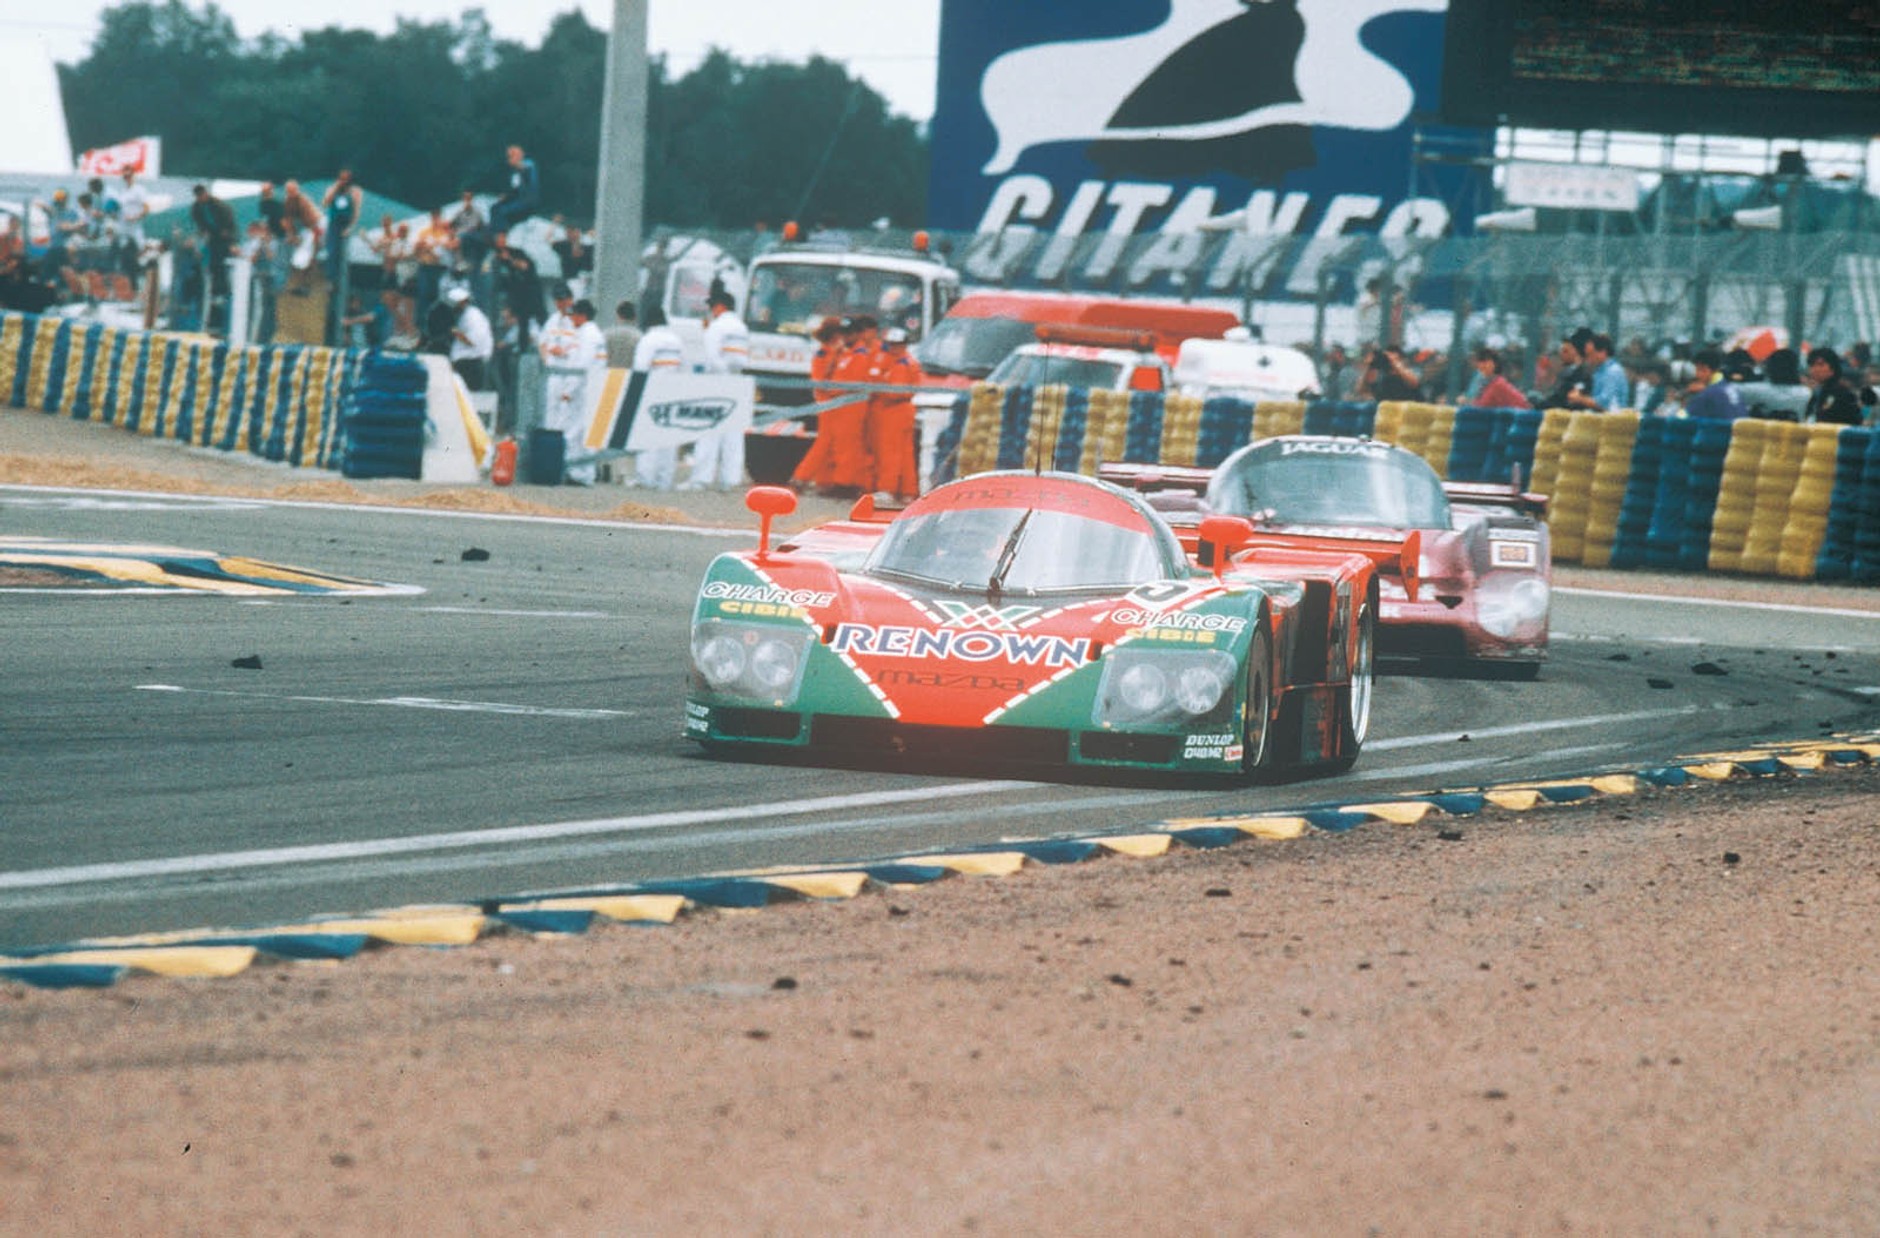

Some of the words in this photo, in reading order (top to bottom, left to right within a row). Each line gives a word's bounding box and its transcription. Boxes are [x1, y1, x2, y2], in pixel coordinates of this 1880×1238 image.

[702, 581, 837, 607] CHARGE
[1112, 608, 1247, 633] CHARGE
[830, 622, 1091, 669] RENOWN
[1185, 733, 1235, 747] DUNLOP
